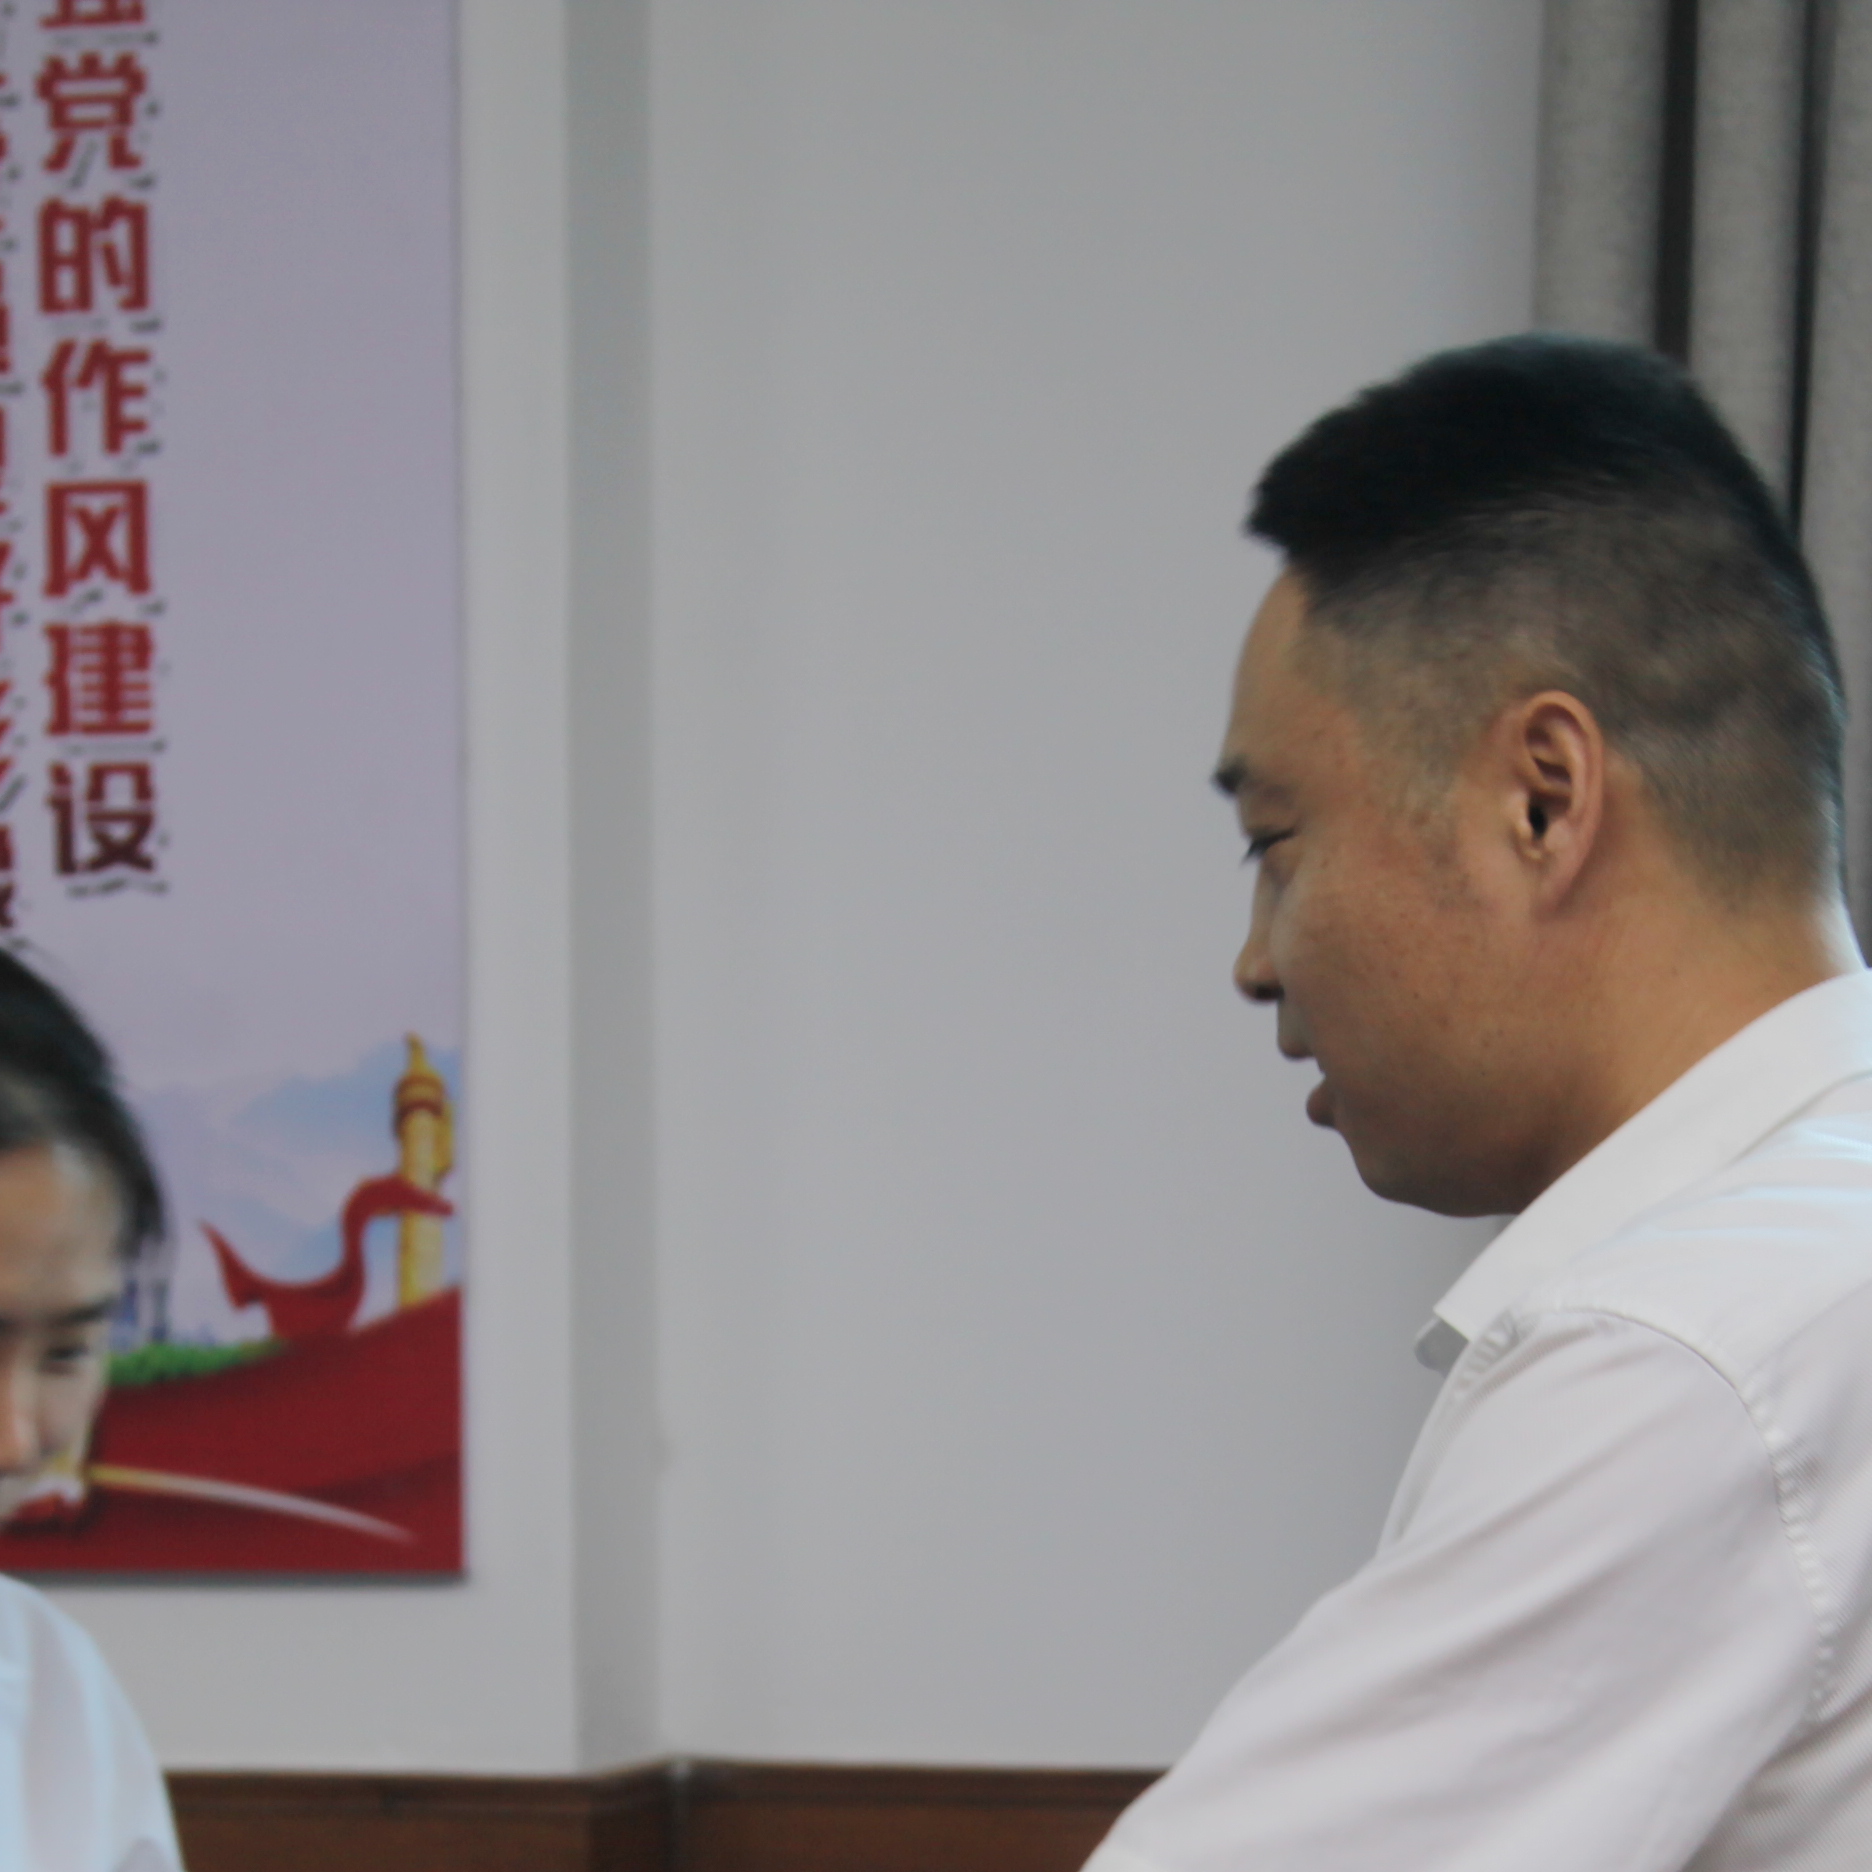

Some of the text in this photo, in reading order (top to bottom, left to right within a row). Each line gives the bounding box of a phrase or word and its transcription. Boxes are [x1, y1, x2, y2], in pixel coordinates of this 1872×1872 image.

[34, 0, 156, 876] 党的作风建设
